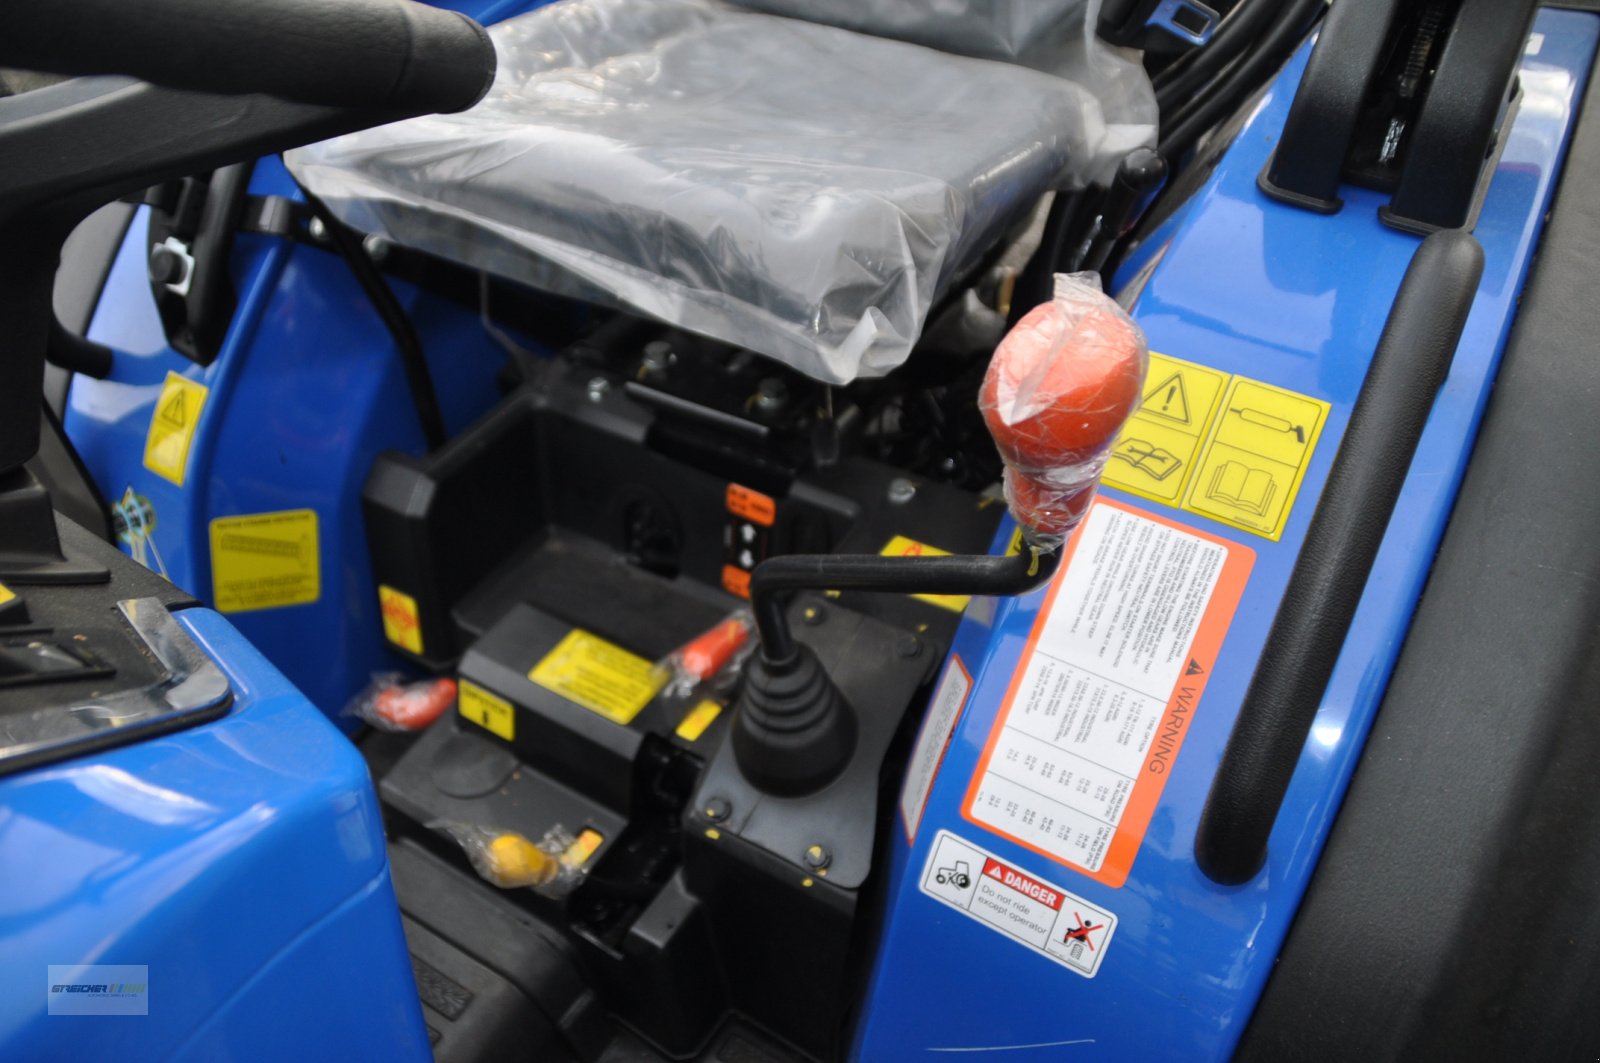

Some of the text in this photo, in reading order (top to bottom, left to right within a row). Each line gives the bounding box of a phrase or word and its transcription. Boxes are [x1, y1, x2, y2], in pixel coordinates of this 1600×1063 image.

[1140, 561, 1152, 582] SAFETY
[1158, 562, 1170, 585] LEVERS
[1167, 565, 1176, 577] PTO
[1175, 565, 1189, 592] STARTING
[1188, 569, 1200, 592] ALWAYS
[1129, 583, 1143, 608] NEUTRAL
[1153, 585, 1161, 596] ARE
[1168, 581, 1176, 593] AND
[1170, 593, 1178, 604] THE
[1192, 587, 1200, 598] THE
[1142, 603, 1154, 624] LOWER
[1162, 604, 1174, 625] ENGINE
[1175, 551, 1221, 657] OPERATING AND SAFETY INSTRUCTIONS
[1124, 613, 1137, 639] STARTER
[1145, 619, 1154, 633] AND
[1175, 599, 1195, 639] INSTRUCTIONS
[1147, 634, 1155, 646] ARE
[1155, 626, 1165, 642] MAKE
[1166, 640, 1179, 663] MANUAL
[1142, 659, 1152, 673] THAT
[1148, 683, 1196, 775] WARNING
[1137, 730, 1150, 753] OPTION
[1109, 788, 1119, 805] ROAD
[1109, 779, 1130, 823] TYRE PRESSURE
[1089, 826, 1111, 870] TYRE PRESSURE
[981, 884, 1031, 915] Do not ride
[1003, 871, 1058, 906] DANGER
[976, 894, 1047, 937] except operator
